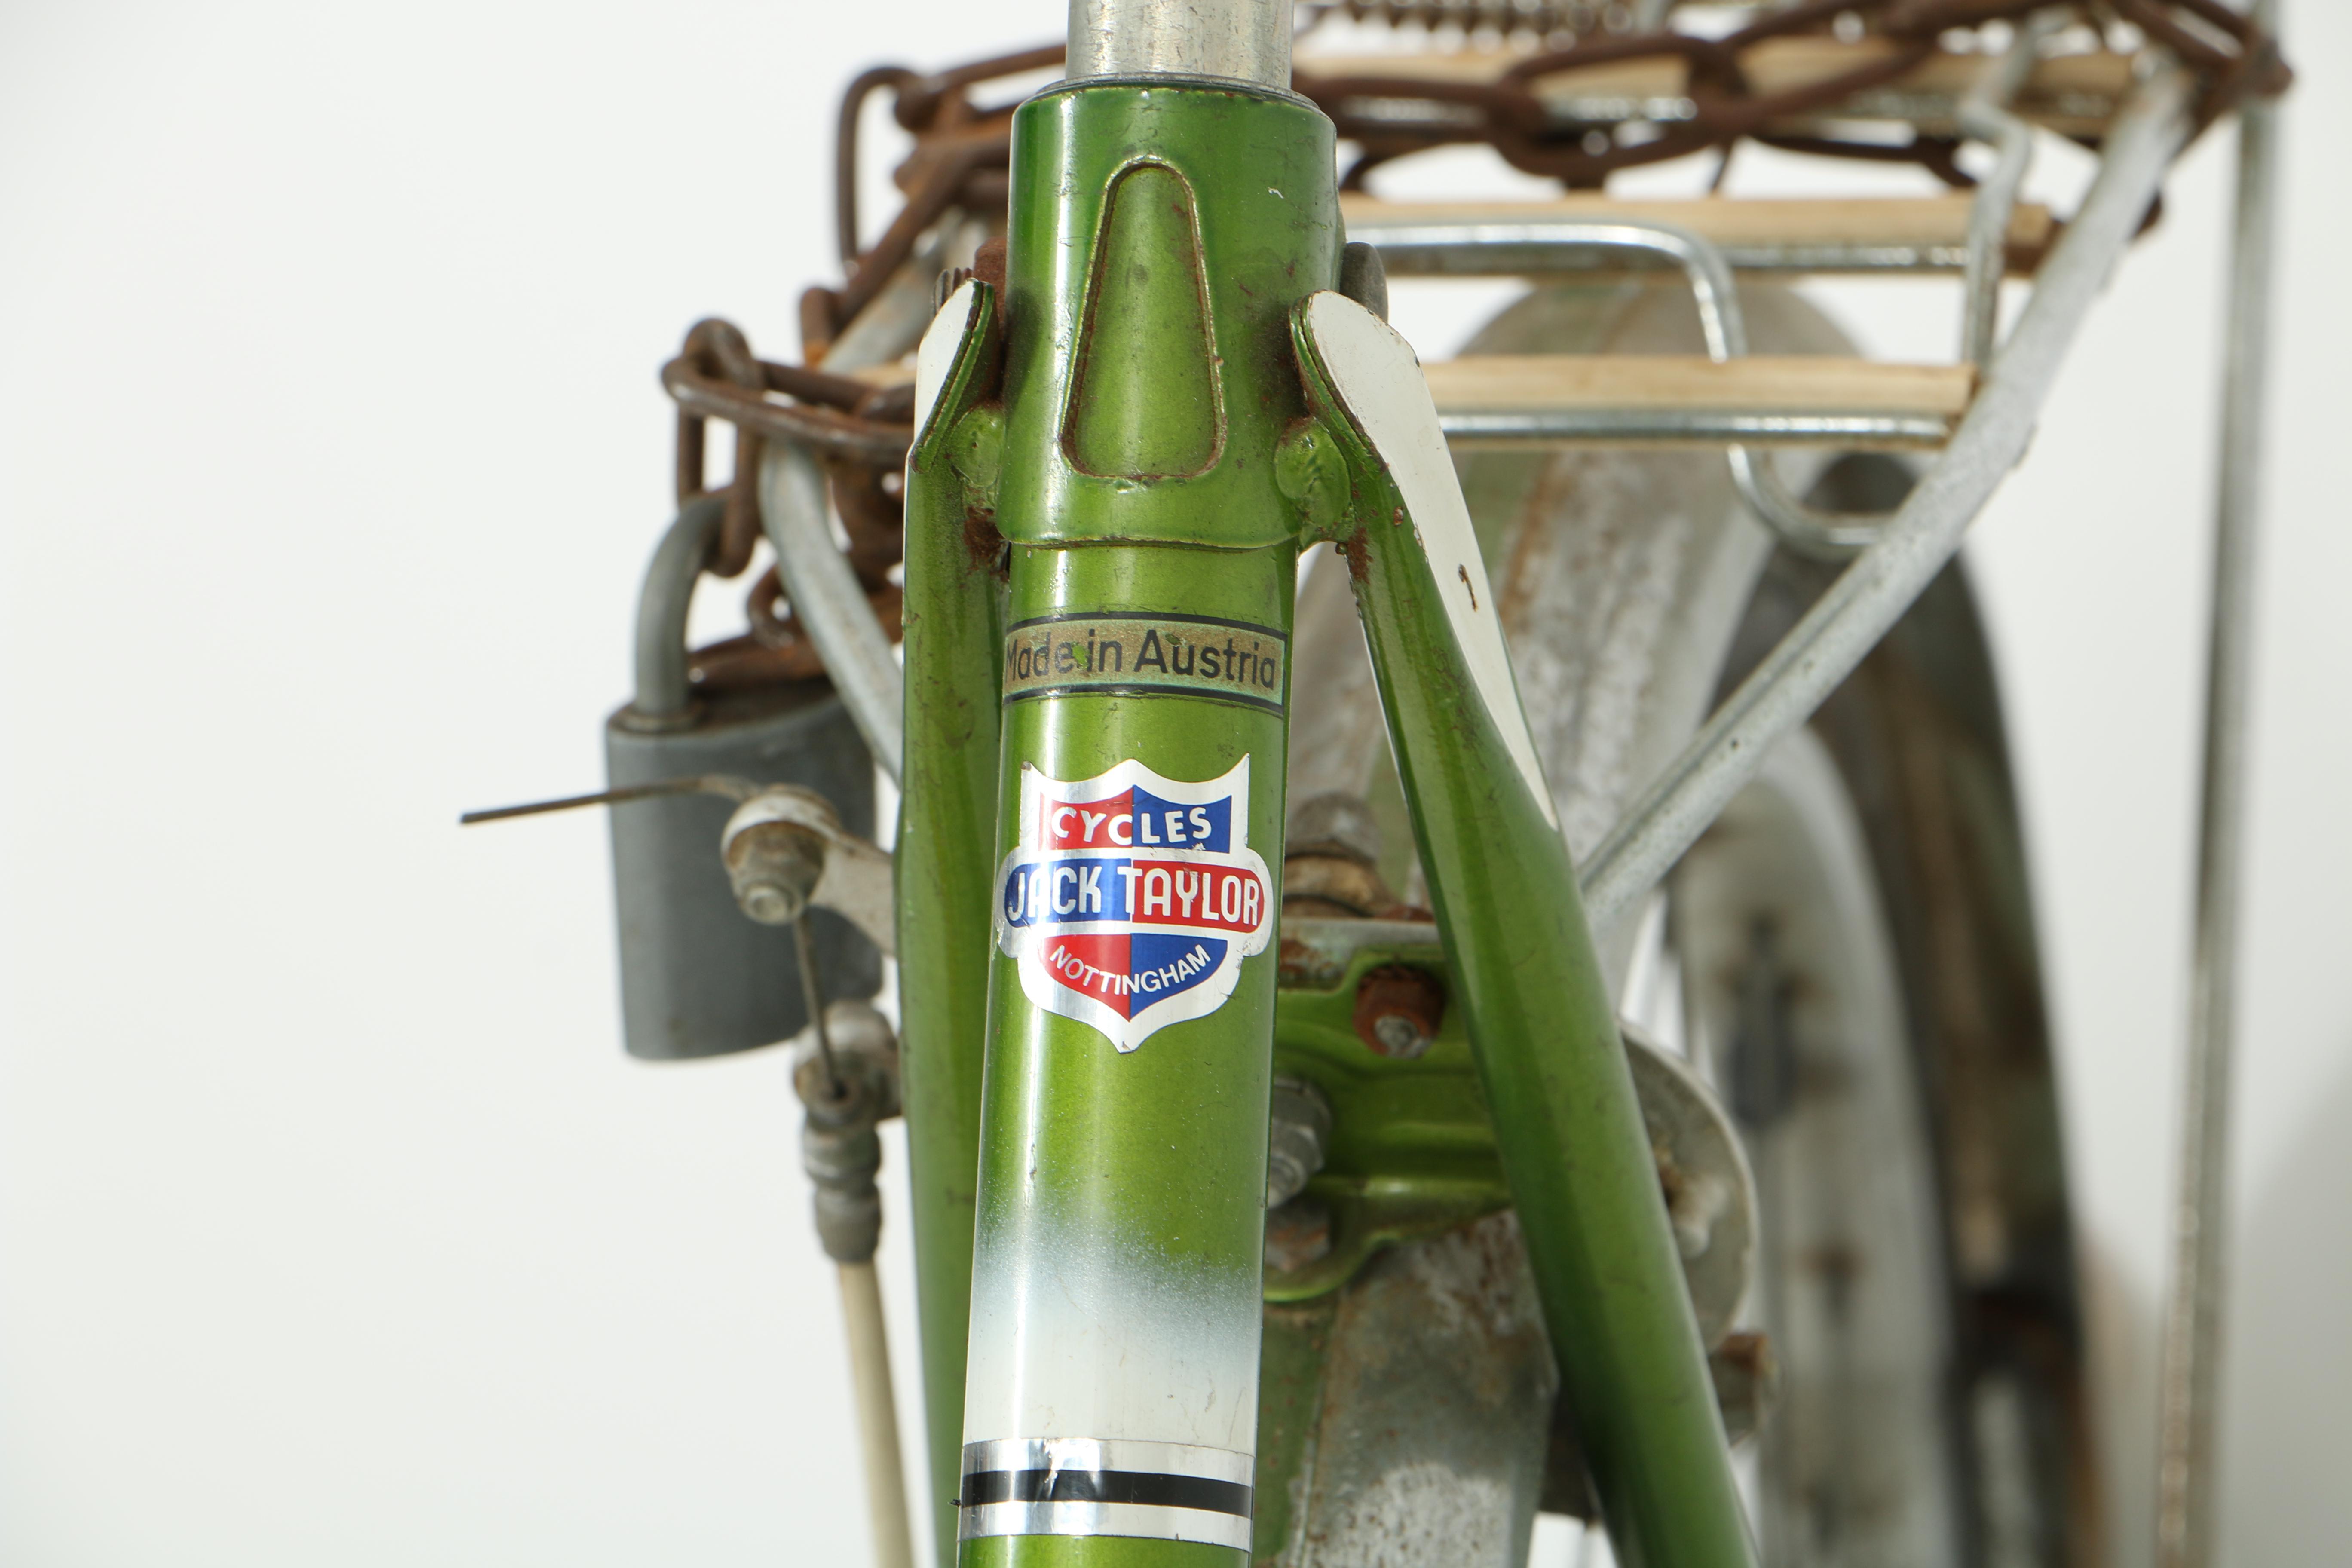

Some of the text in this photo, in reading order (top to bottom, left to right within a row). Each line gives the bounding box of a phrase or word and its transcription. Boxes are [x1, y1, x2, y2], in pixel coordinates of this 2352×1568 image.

[1005, 628, 1276, 689] Made in Austria
[1051, 806, 1212, 846] CYCLES
[1008, 866, 1259, 926] JACK TAYLOR
[1049, 944, 1211, 995] NOTTINGHAM
